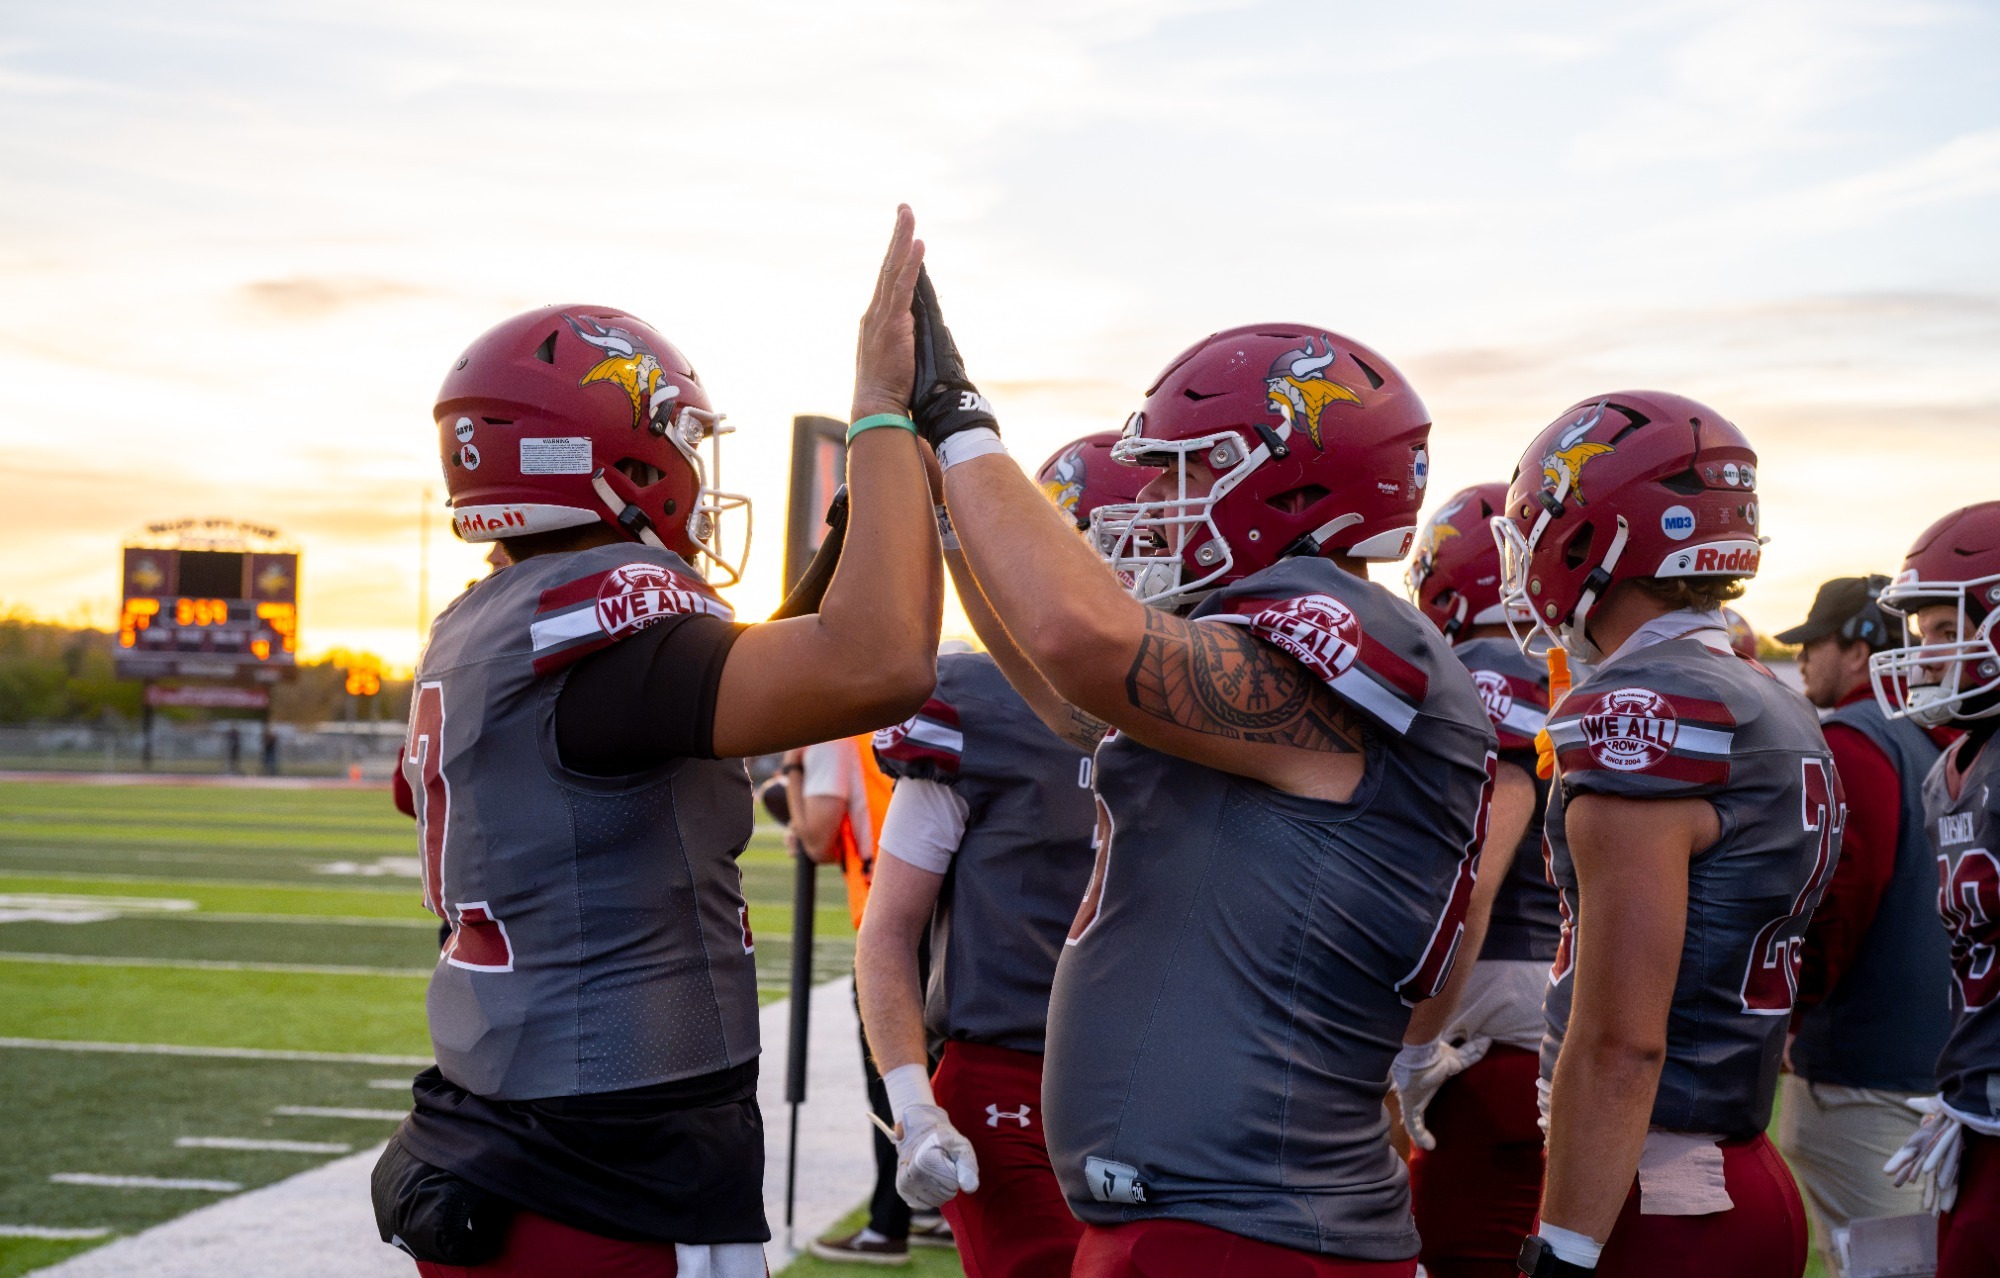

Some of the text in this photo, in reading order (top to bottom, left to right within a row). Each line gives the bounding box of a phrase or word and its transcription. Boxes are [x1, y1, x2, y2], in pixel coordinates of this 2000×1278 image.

[1665, 517, 1692, 530] MD3
[600, 592, 649, 629] WE
[1257, 611, 1347, 677] WE ALL
[1276, 638, 1306, 659] ROW
[1584, 717, 1671, 749] WE ALL
[1611, 741, 1639, 751] ROW
[1604, 754, 1642, 766] SINCE 2004
